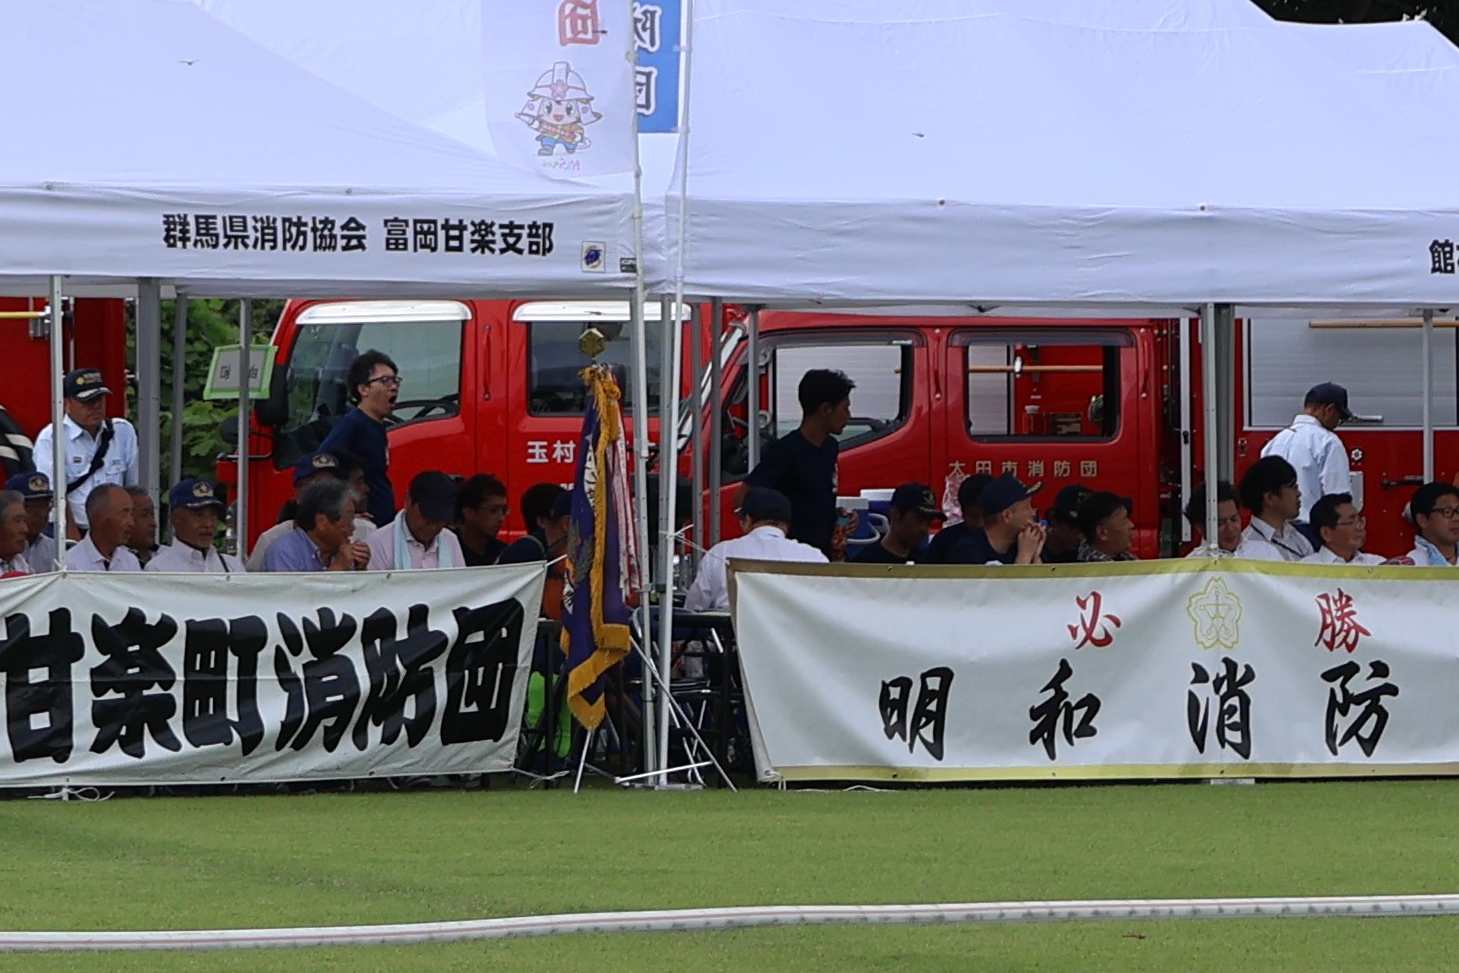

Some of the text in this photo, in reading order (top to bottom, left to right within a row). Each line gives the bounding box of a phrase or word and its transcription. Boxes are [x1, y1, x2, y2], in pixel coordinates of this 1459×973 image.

[163, 213, 555, 257] 群馬県消防協会 富岡甘楽支部
[1429, 238, 1459, 274] 館
[948, 460, 1098, 477] 太田市消防団
[877, 656, 1401, 762] 明和消防
